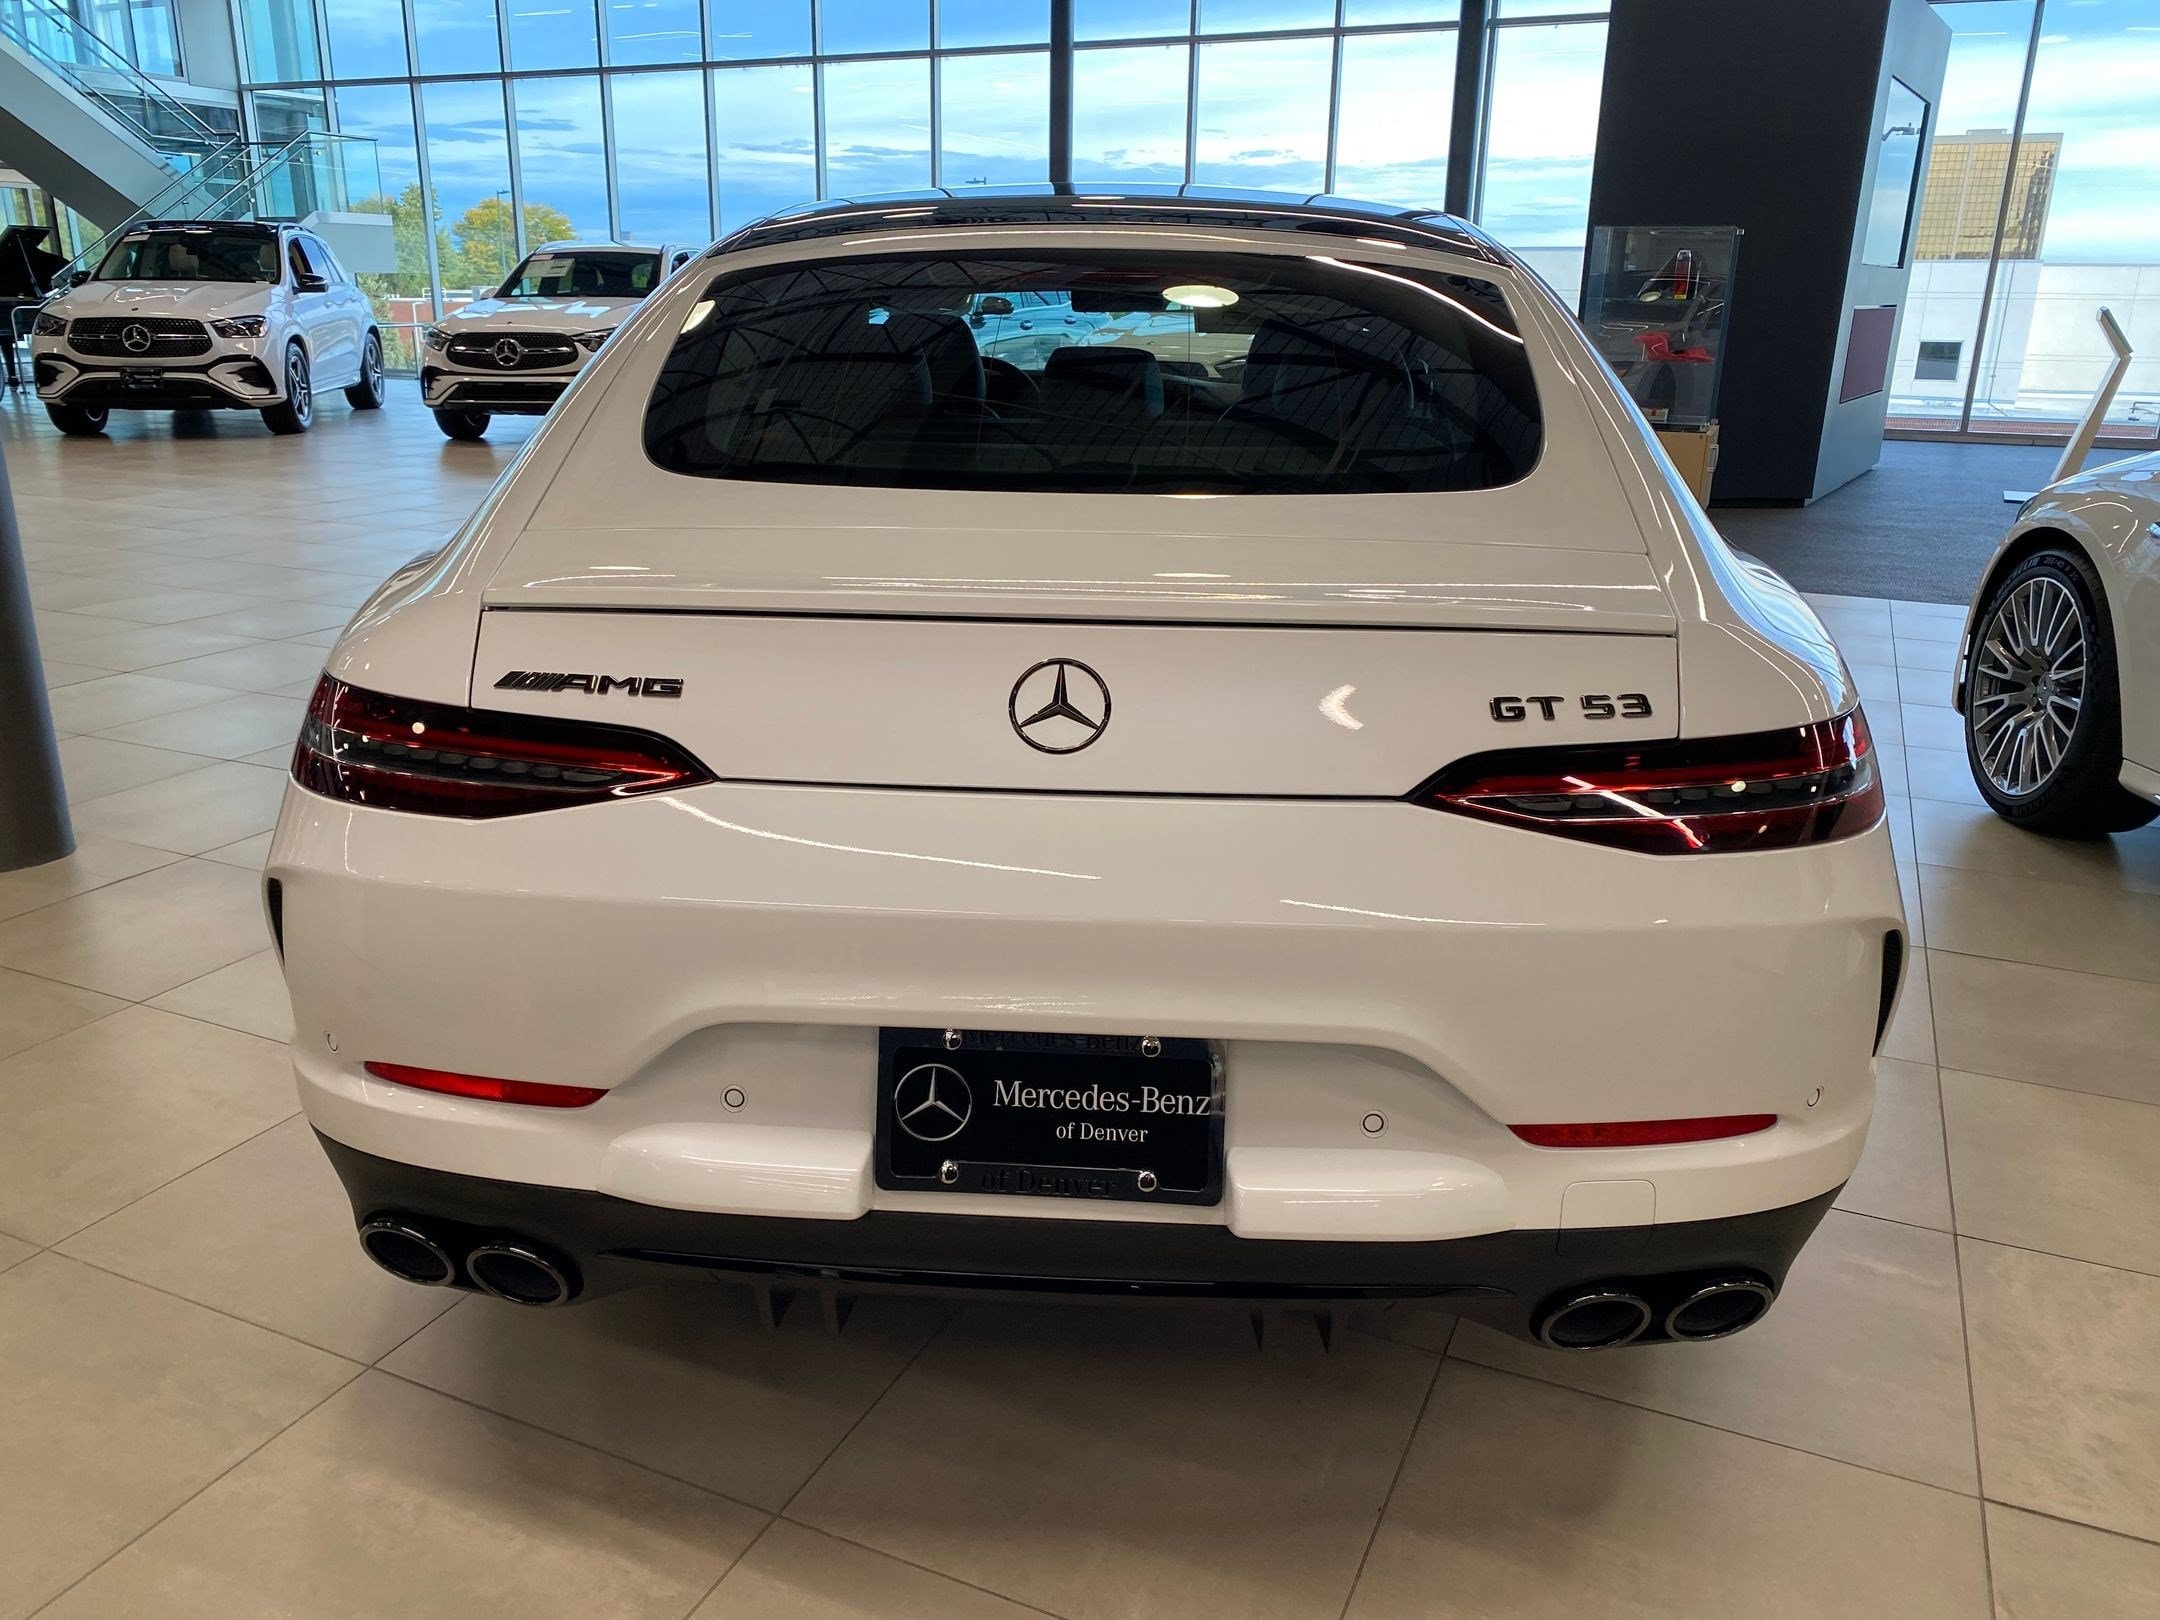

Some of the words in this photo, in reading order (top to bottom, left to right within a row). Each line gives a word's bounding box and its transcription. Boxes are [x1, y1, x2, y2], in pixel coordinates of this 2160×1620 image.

[551, 674, 684, 698] AMG
[1489, 696, 1565, 722] GT
[1580, 693, 1653, 720] 53
[993, 1079, 1211, 1116] Mercedes-Benz
[1056, 1122, 1075, 1139] of
[1079, 1123, 1149, 1143] Denver
[1015, 1169, 1116, 1198] Denver
